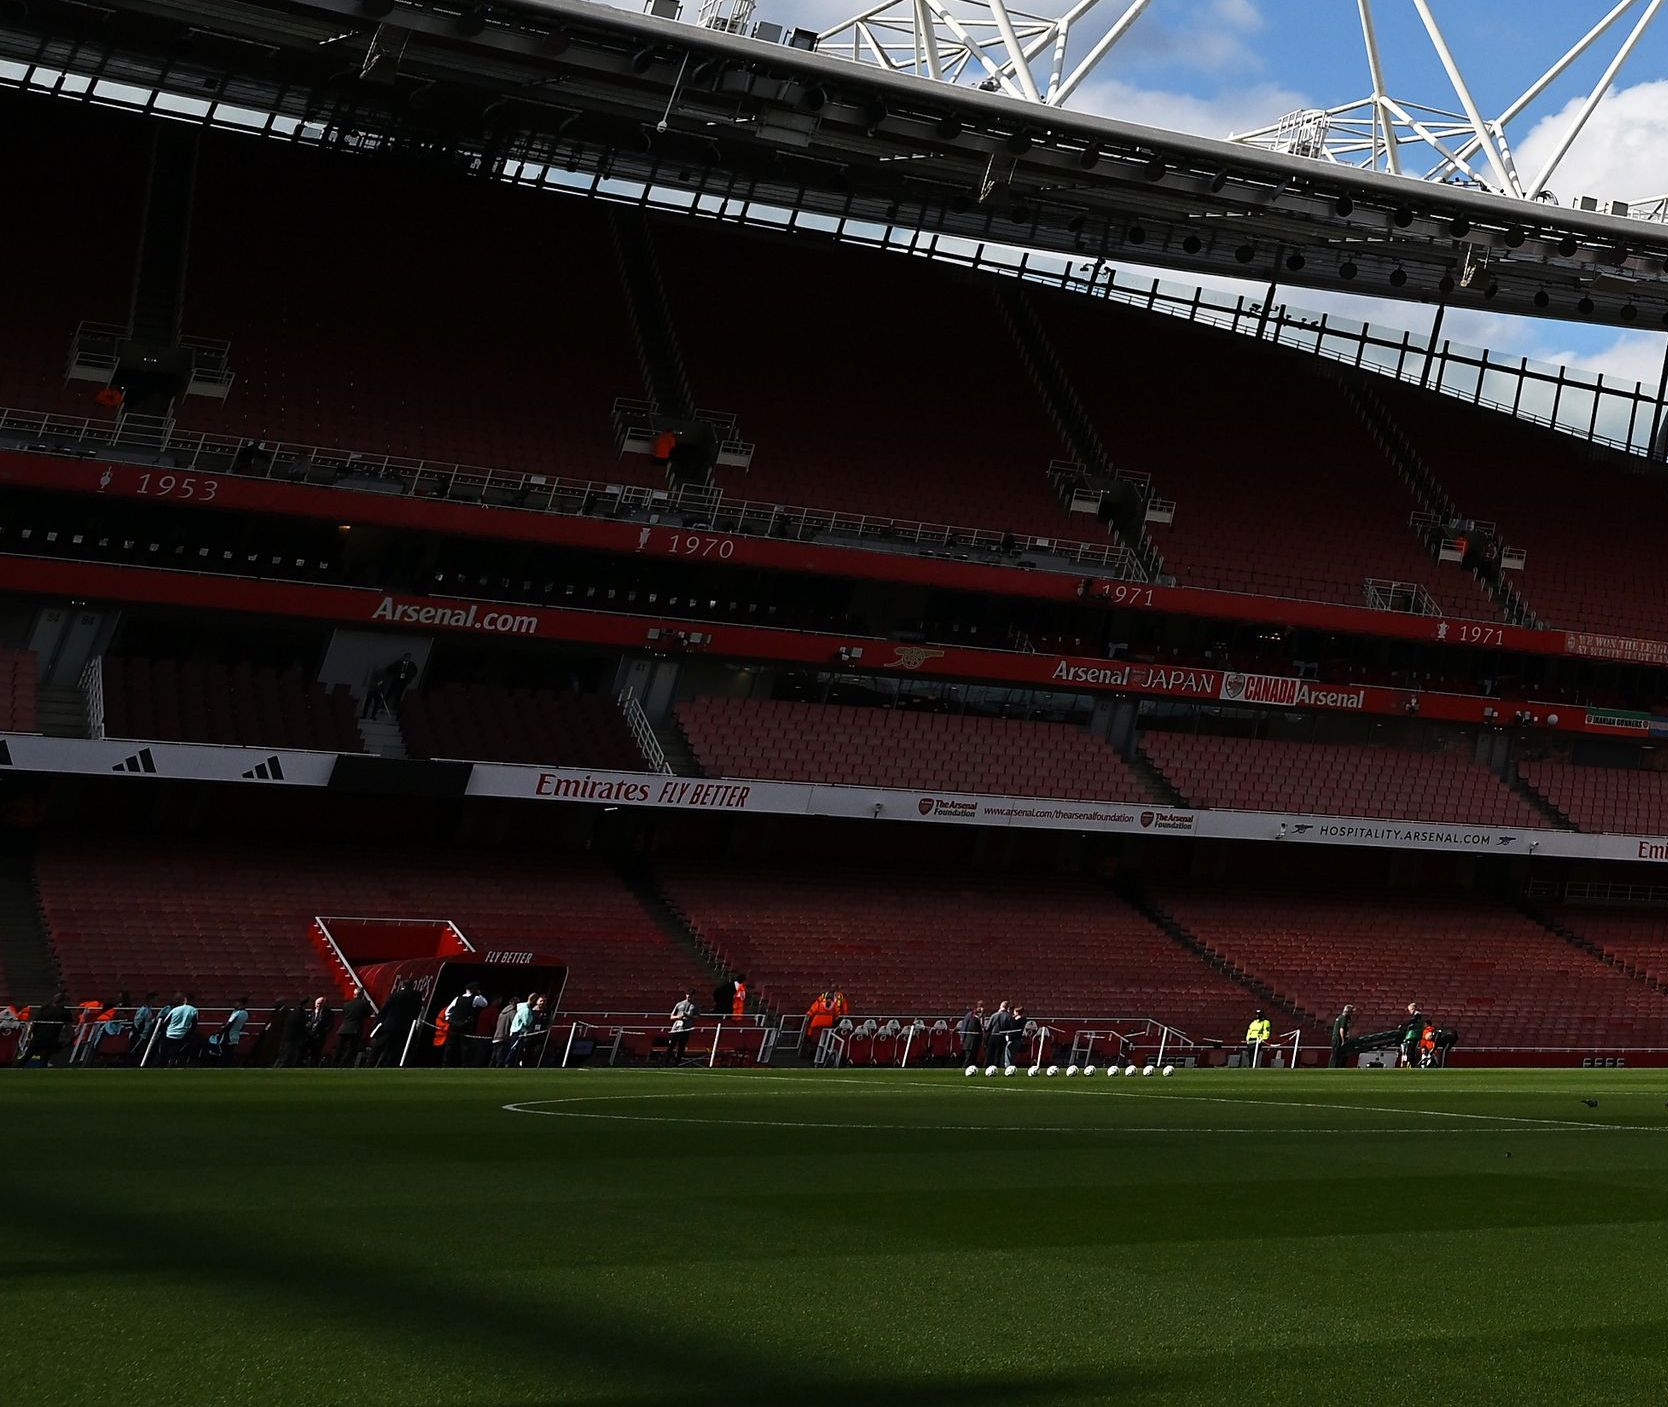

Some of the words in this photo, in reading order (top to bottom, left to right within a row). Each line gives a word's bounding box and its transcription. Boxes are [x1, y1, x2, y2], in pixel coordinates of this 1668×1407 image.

[136, 473, 219, 501] 1953
[668, 534, 734, 559] 1970
[1101, 584, 1154, 608] 1971
[371, 597, 538, 636] Arsenal.com
[1459, 625, 1504, 647] 1971
[1595, 637, 1617, 649] WON
[1619, 639, 1638, 651] THE
[1052, 660, 1131, 686] Arsenal
[1141, 668, 1214, 694] JAPAN
[1244, 677, 1296, 704] CANADA
[1296, 688, 1365, 710] Arsenal
[536, 774, 650, 802] Emirates
[658, 782, 690, 804] FLY
[689, 783, 751, 807] BETTER
[933, 807, 976, 818] Foundation
[935, 800, 947, 809] The
[946, 800, 978, 811] Arsenal
[984, 806, 1134, 823] www.arsenal.com/thearsenalfoundation
[1154, 820, 1192, 830] Foundation
[1156, 812, 1169, 821] The
[1169, 813, 1194, 824] Arsenal
[1320, 825, 1491, 846] HOSPITALITY.ARSENAL.COM
[484, 951, 500, 963] FLY
[501, 952, 533, 964] BETTER
